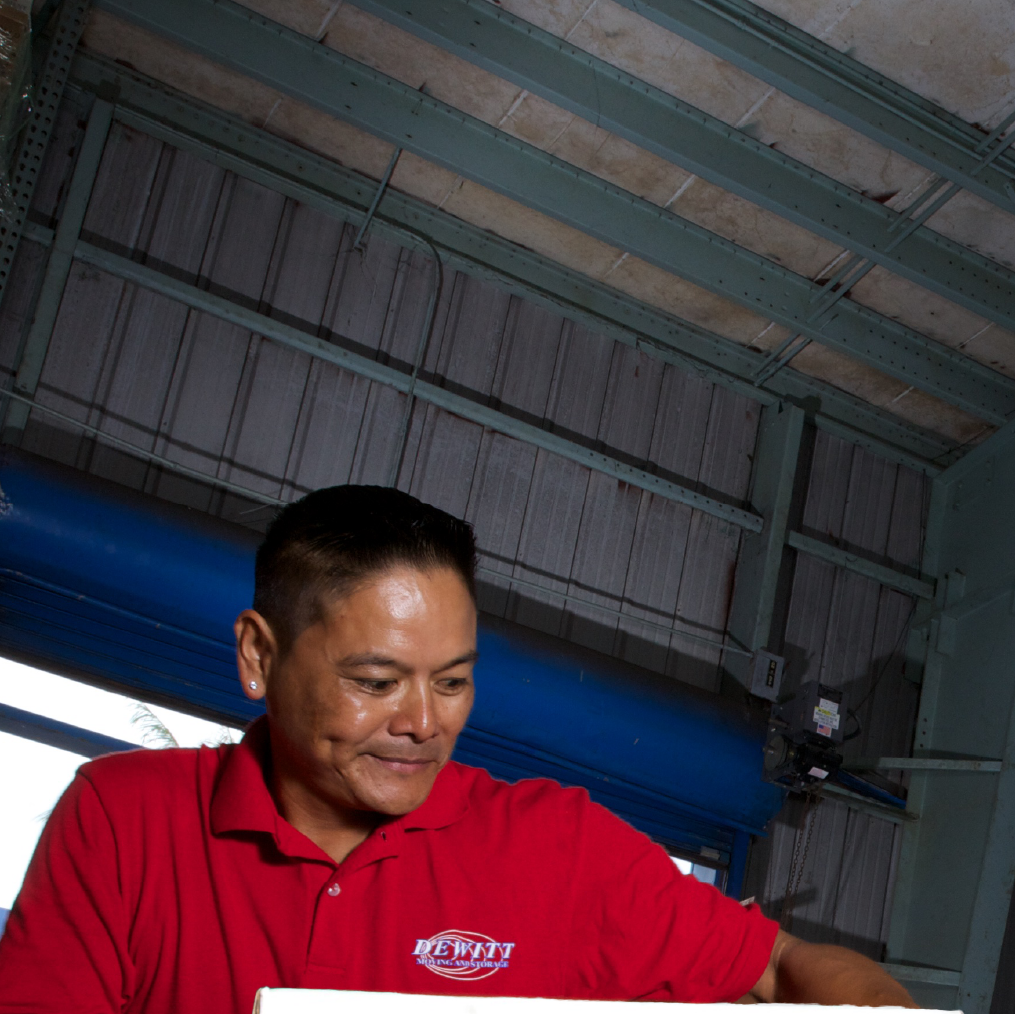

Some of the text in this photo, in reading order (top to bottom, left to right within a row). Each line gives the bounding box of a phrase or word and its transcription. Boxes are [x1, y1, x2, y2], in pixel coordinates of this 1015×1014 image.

[411, 938, 515, 959] DEWITT
[416, 957, 453, 967] MOVING
[470, 960, 509, 968] STORAGE
